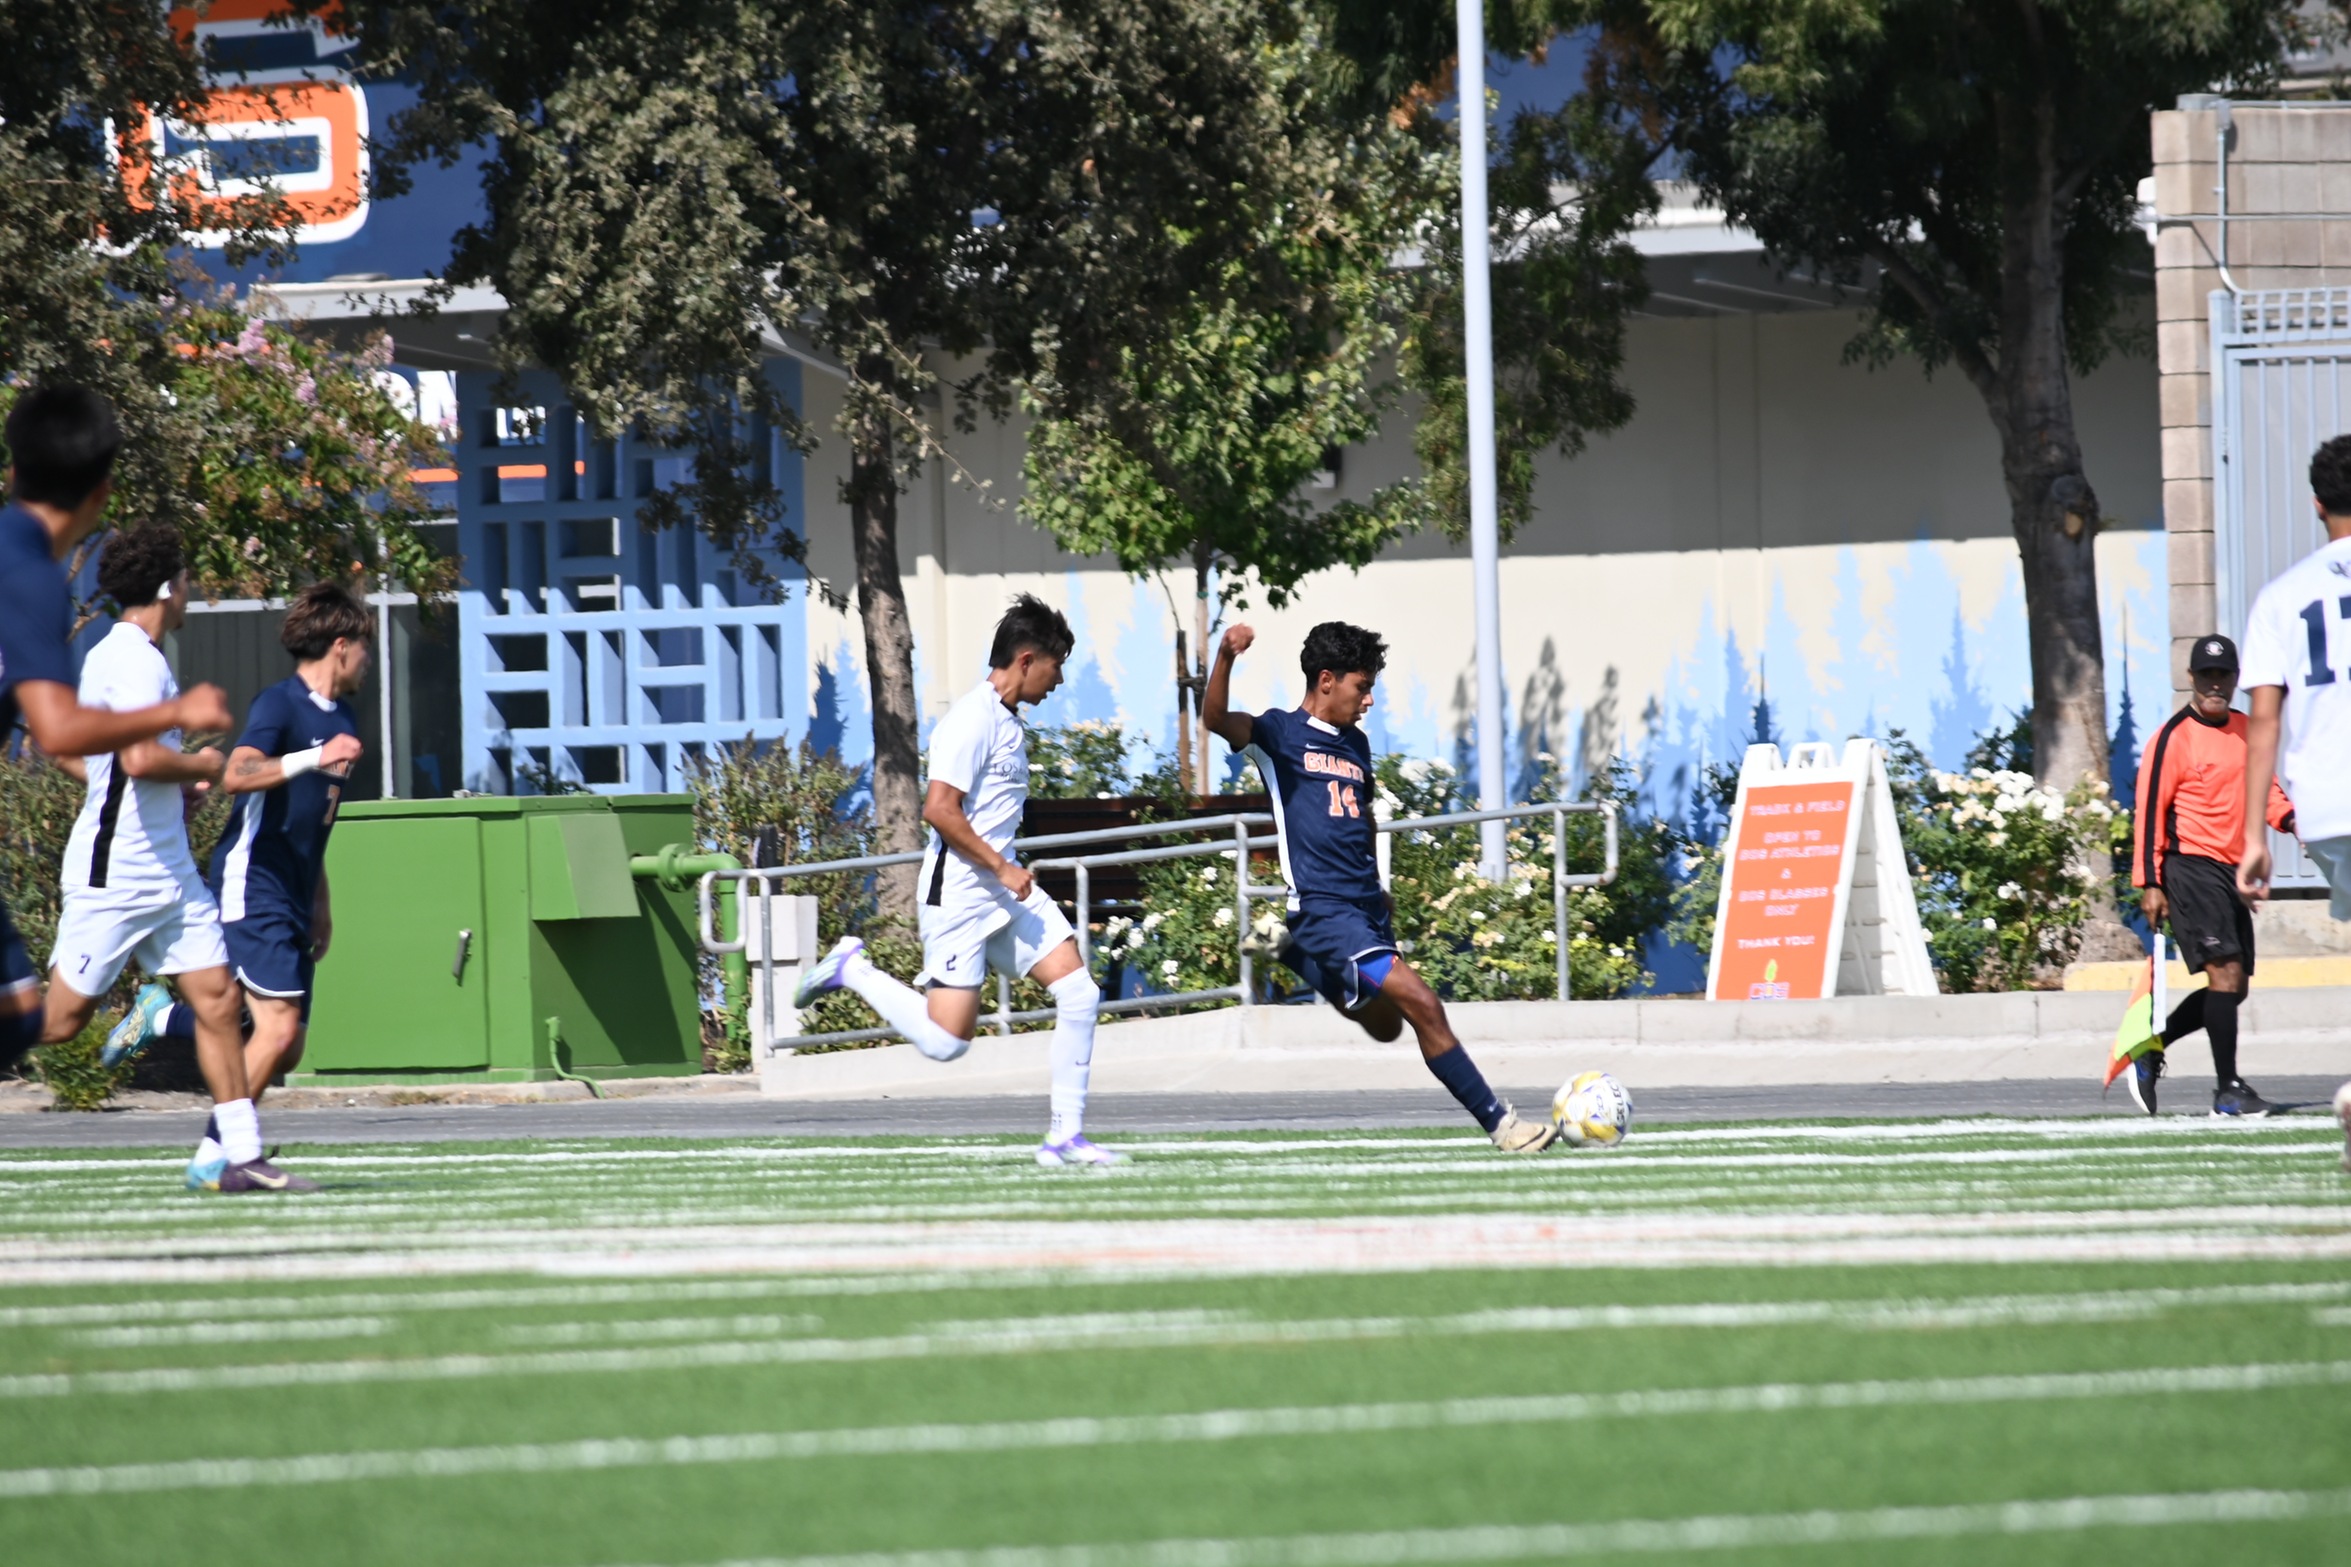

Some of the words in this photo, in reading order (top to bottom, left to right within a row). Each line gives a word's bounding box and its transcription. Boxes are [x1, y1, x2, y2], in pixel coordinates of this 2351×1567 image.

[1327, 780, 1360, 818] 14
[1750, 803, 1791, 816] TRACK
[1794, 802, 1804, 814] &
[1806, 800, 1846, 812] FIELD
[1764, 831, 1799, 844] OPEN
[1803, 829, 1821, 841] TO
[1781, 868, 1791, 879] &
[1764, 904, 1799, 917] ONLY
[1738, 936, 1781, 949] THANK
[78, 953, 92, 975] 7
